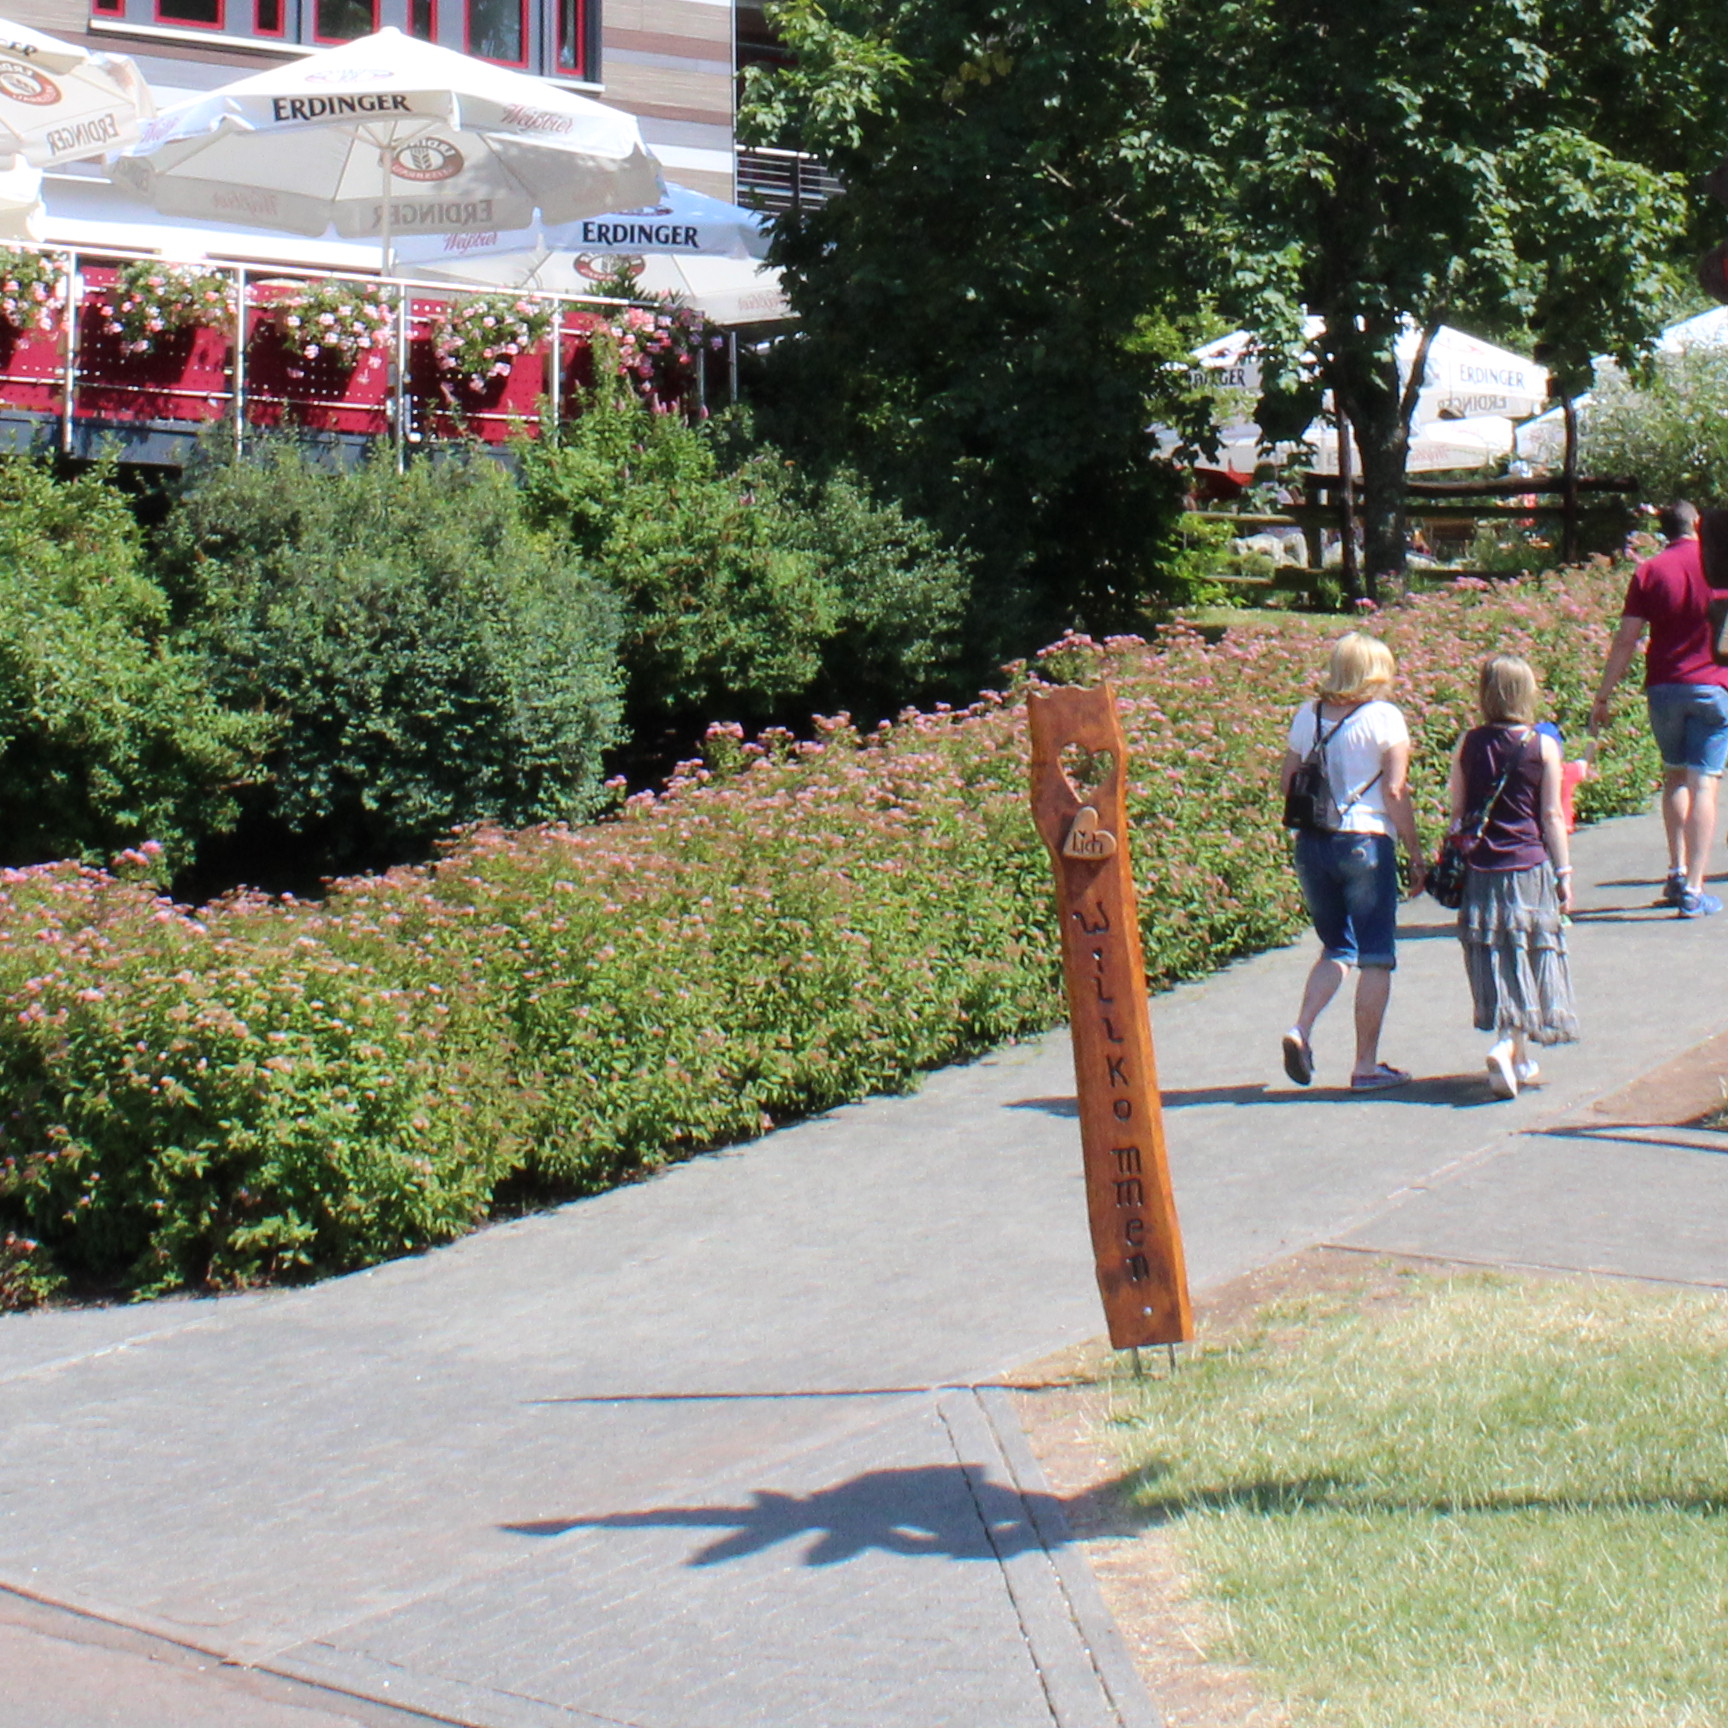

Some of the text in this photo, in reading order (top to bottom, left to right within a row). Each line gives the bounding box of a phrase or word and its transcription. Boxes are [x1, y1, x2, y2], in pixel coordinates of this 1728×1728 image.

[273, 93, 414, 122] ERDINGER
[582, 221, 701, 248] ERDINGER
[1460, 363, 1525, 391] ERDINGER
